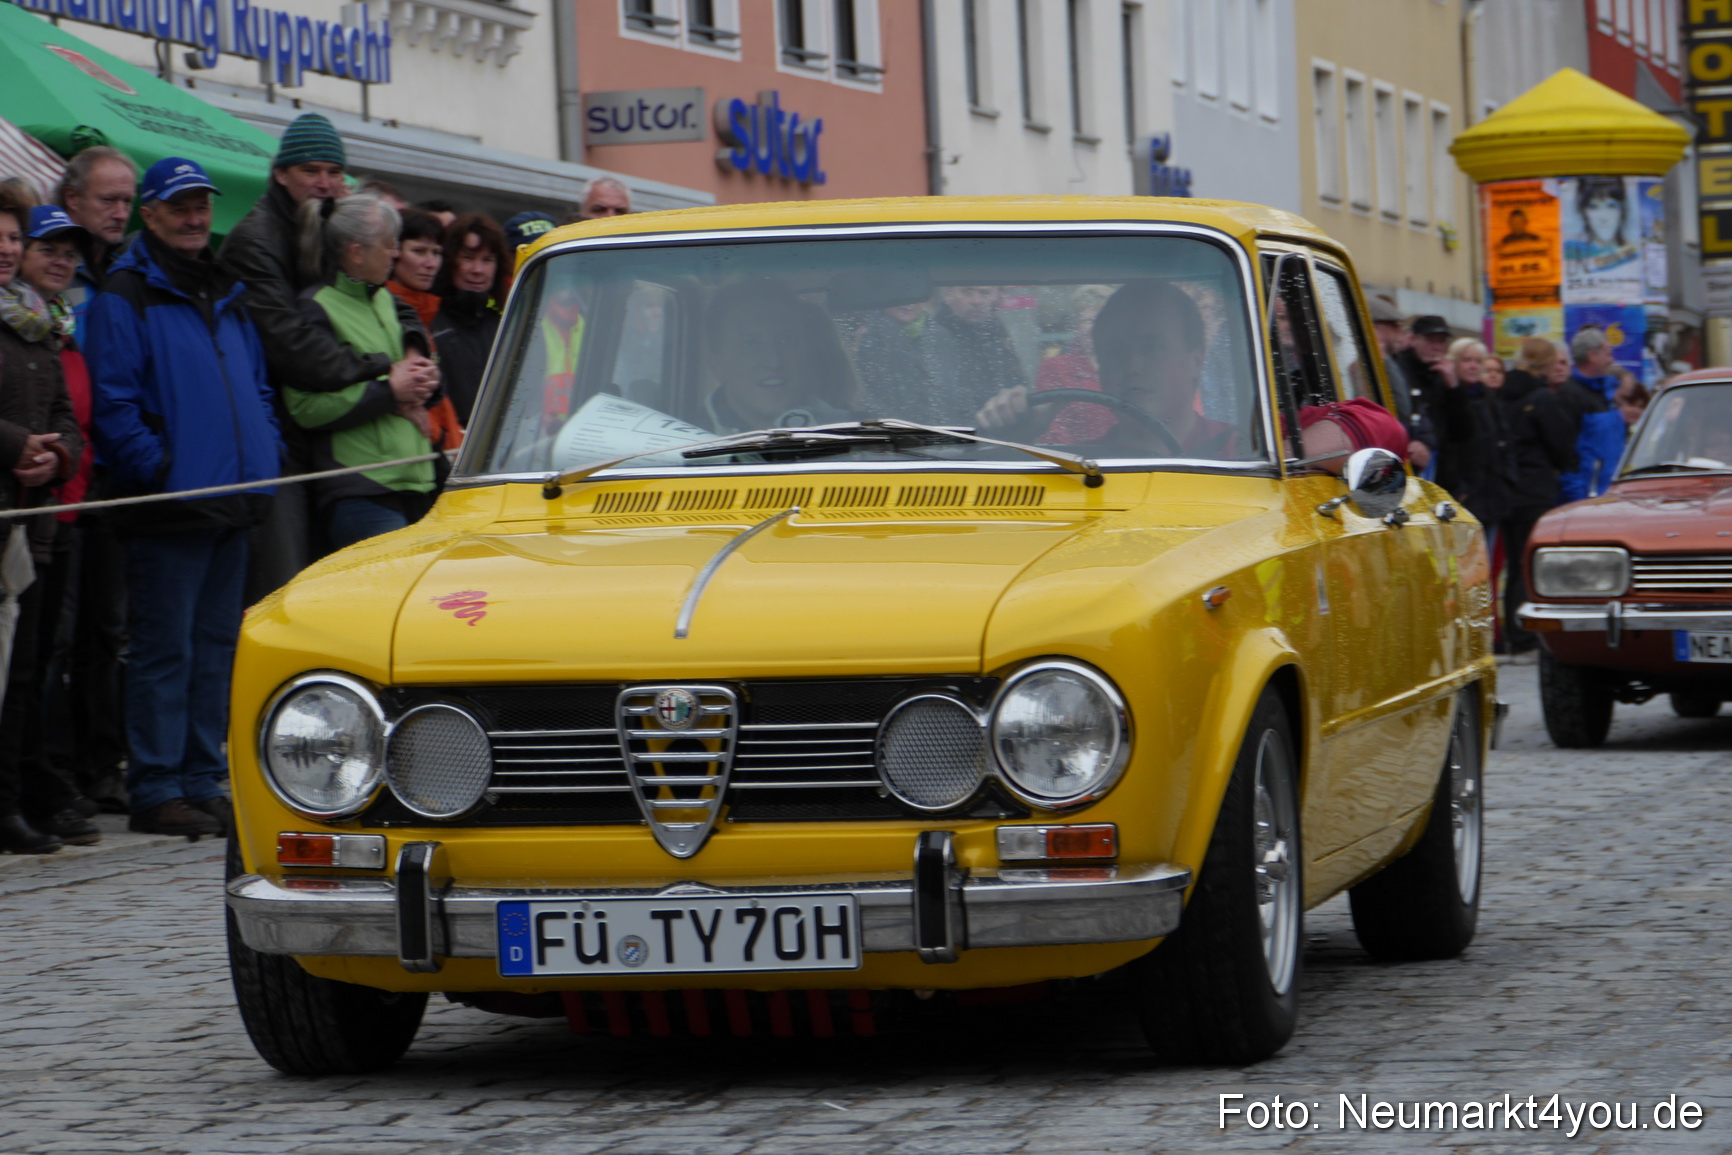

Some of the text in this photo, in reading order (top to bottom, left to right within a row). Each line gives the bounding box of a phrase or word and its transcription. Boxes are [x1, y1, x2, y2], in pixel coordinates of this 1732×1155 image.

[233, 0, 392, 87] Rupprecht
[510, 946, 523, 962] D
[535, 910, 609, 966] FÜ
